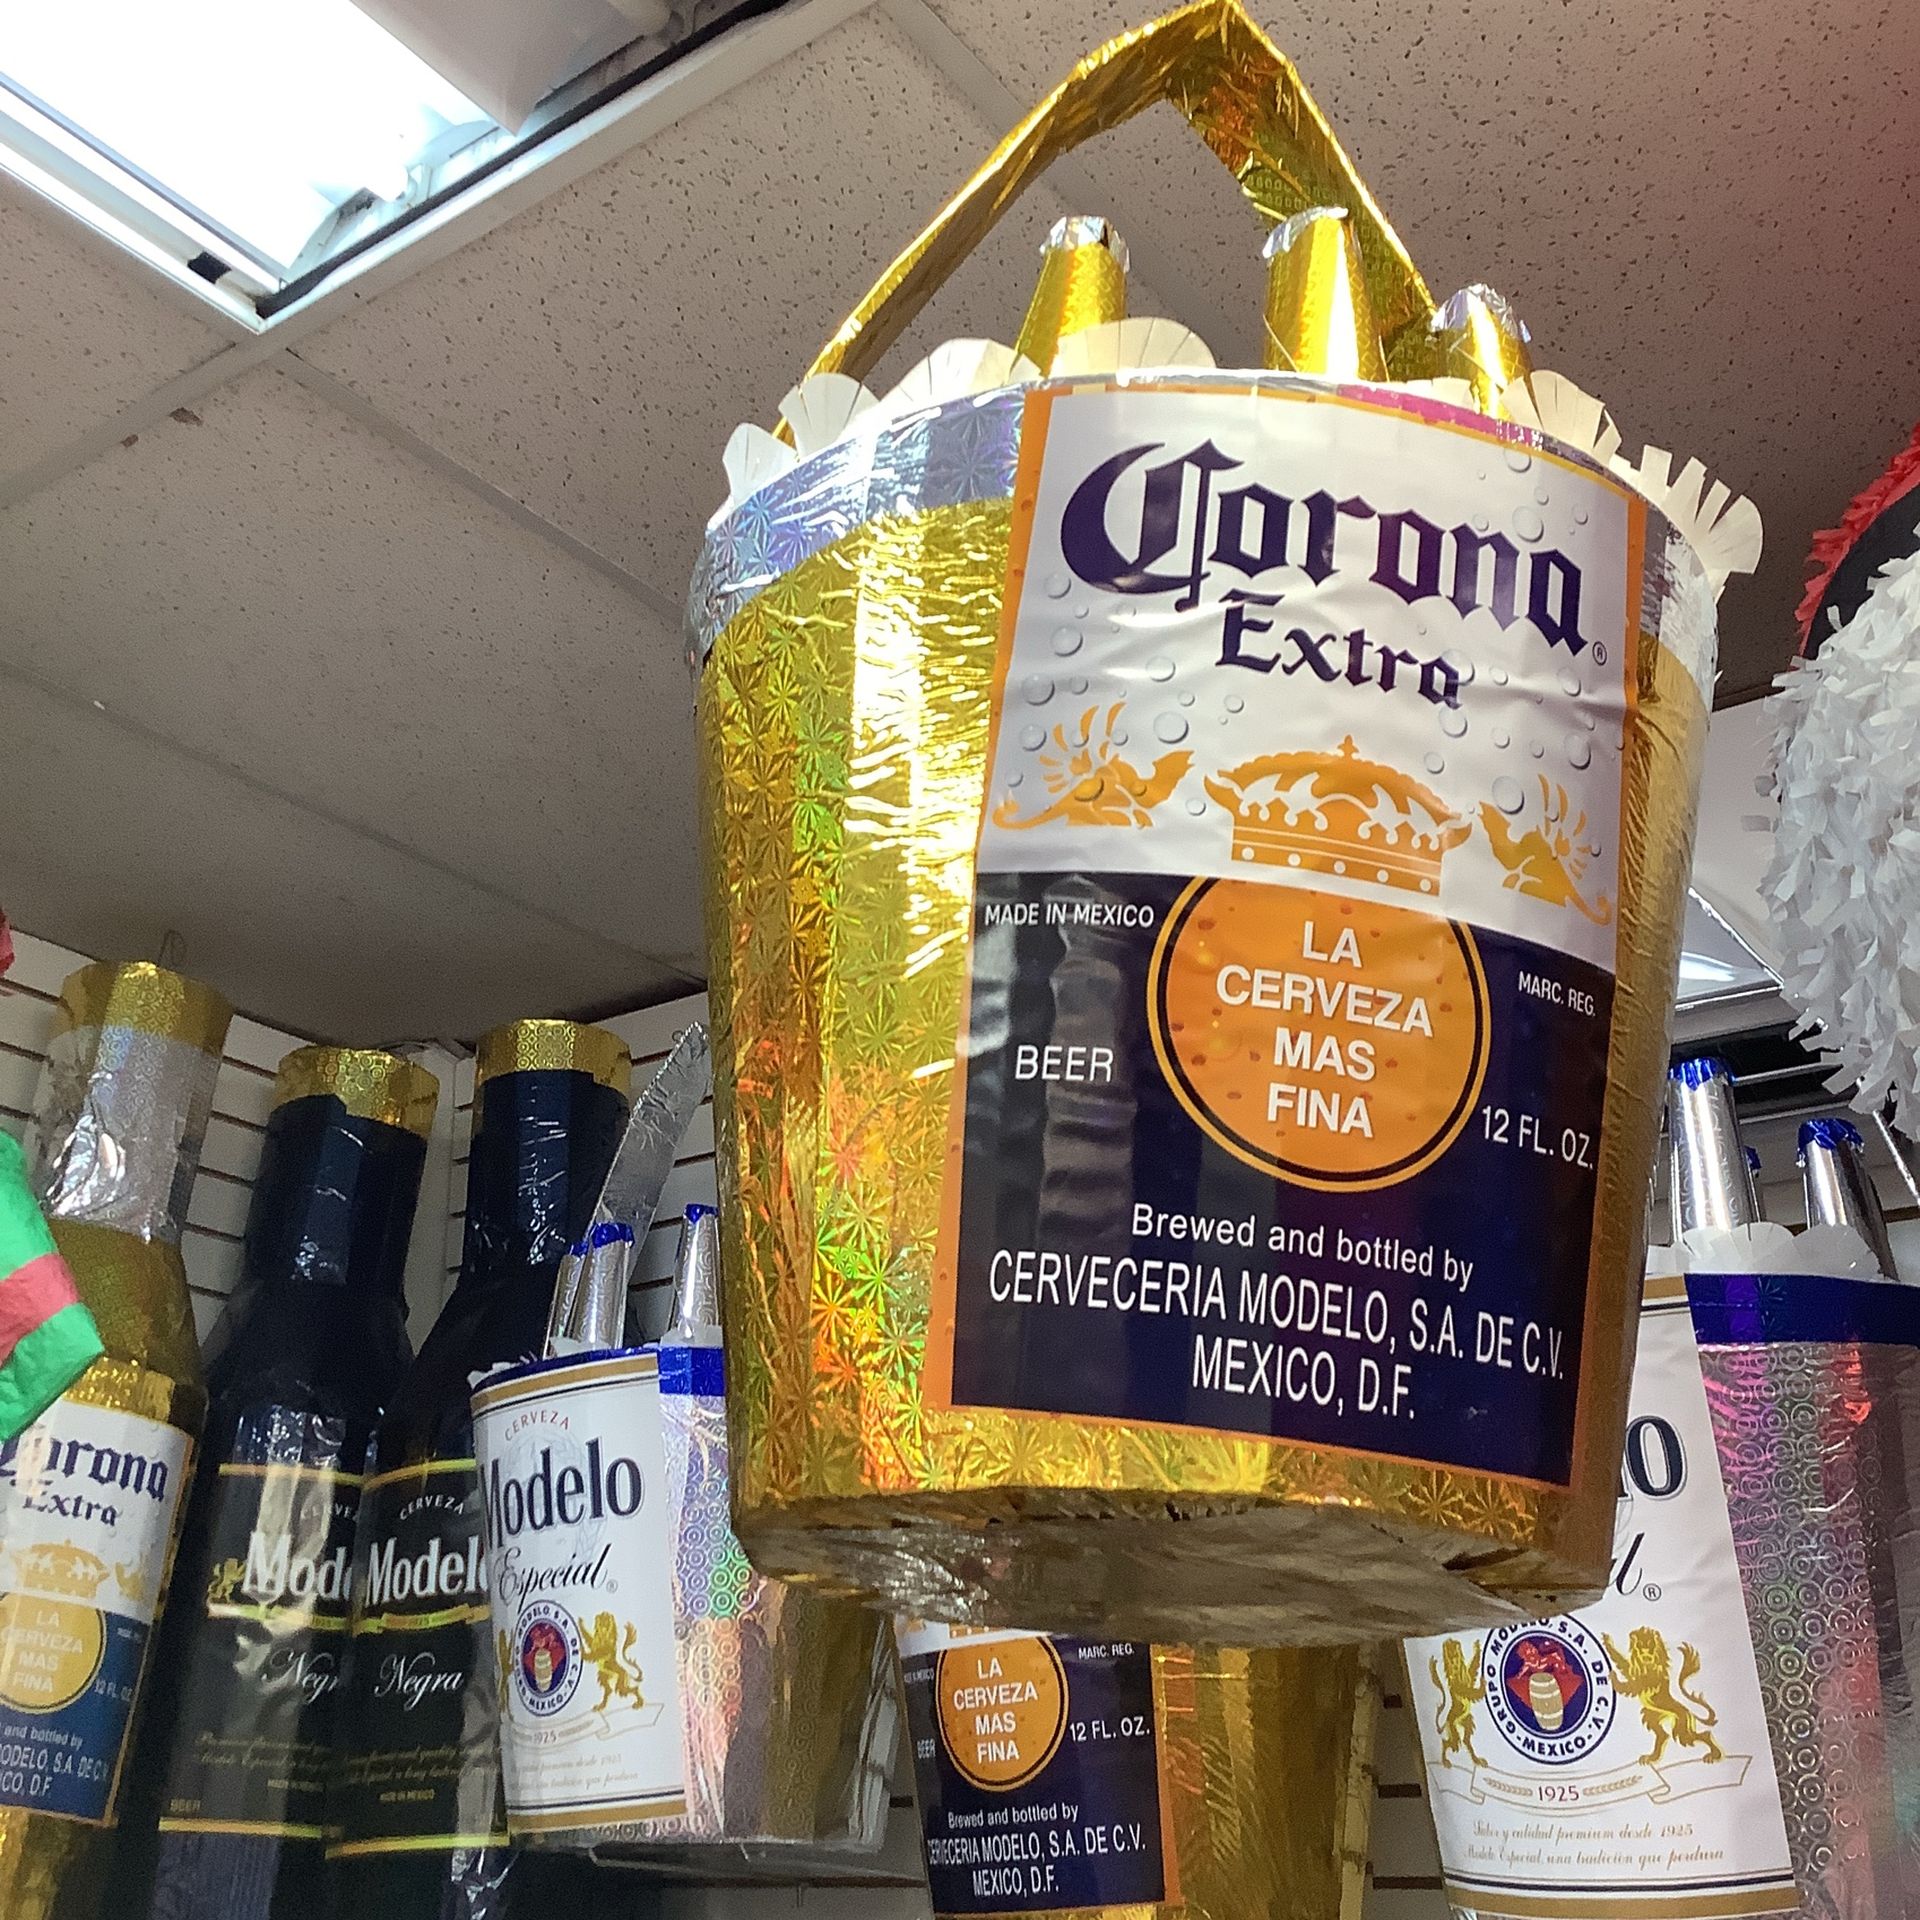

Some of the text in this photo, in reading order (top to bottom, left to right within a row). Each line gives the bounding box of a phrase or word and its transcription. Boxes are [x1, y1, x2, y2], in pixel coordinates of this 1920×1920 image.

[1061, 439, 1588, 656] Corona
[1216, 588, 1463, 710] Extra
[985, 903, 1155, 927] MADE IN MEXICO
[1303, 920, 1362, 968] LA
[1216, 964, 1433, 1038] CERVEZA
[1518, 971, 1597, 1016] MARC. REG.
[1015, 1045, 1114, 1082] BEER
[1273, 1026, 1376, 1081] MAS
[1267, 1081, 1374, 1139] FINA
[1482, 1105, 1594, 1170] 12 FL. OZ.
[1132, 1203, 1474, 1293] Brewed and bottled by
[989, 1249, 1564, 1380] CERVECERIA MODELO, S.A. DE C.V.
[1192, 1334, 1415, 1419] MEXICO, D.F.
[505, 1410, 570, 1442] CERVEZA
[400, 1493, 465, 1521] CERVEZA
[479, 1436, 643, 1551] Modelo
[494, 1543, 612, 1614] Especial
[1558, 1621, 1588, 1655] S.A.
[374, 1652, 463, 1711] Negra
[977, 1657, 1002, 1679] LA
[1591, 1660, 1609, 1686] DE
[953, 1680, 1039, 1711] CERVEZA
[1486, 1665, 1517, 1734] GRUPO
[1588, 1696, 1609, 1730] C.V.
[975, 1711, 1016, 1736] MAS
[1069, 1715, 1150, 1742] 12 FL. OZ.
[0, 1744, 49, 1773] ODELO,
[976, 1740, 1020, 1764] FINA
[1538, 1785, 1580, 1801] 1925
[948, 1802, 1079, 1829] Brewed and bottled by
[1660, 1823, 1694, 1838] 1925
[981, 1831, 1046, 1863] MODELO,
[1049, 1829, 1081, 1858] S.A.
[1084, 1825, 1109, 1855] DE
[1113, 1822, 1146, 1852] C.V.
[972, 1864, 1060, 1898] MEXICO, D.F.
